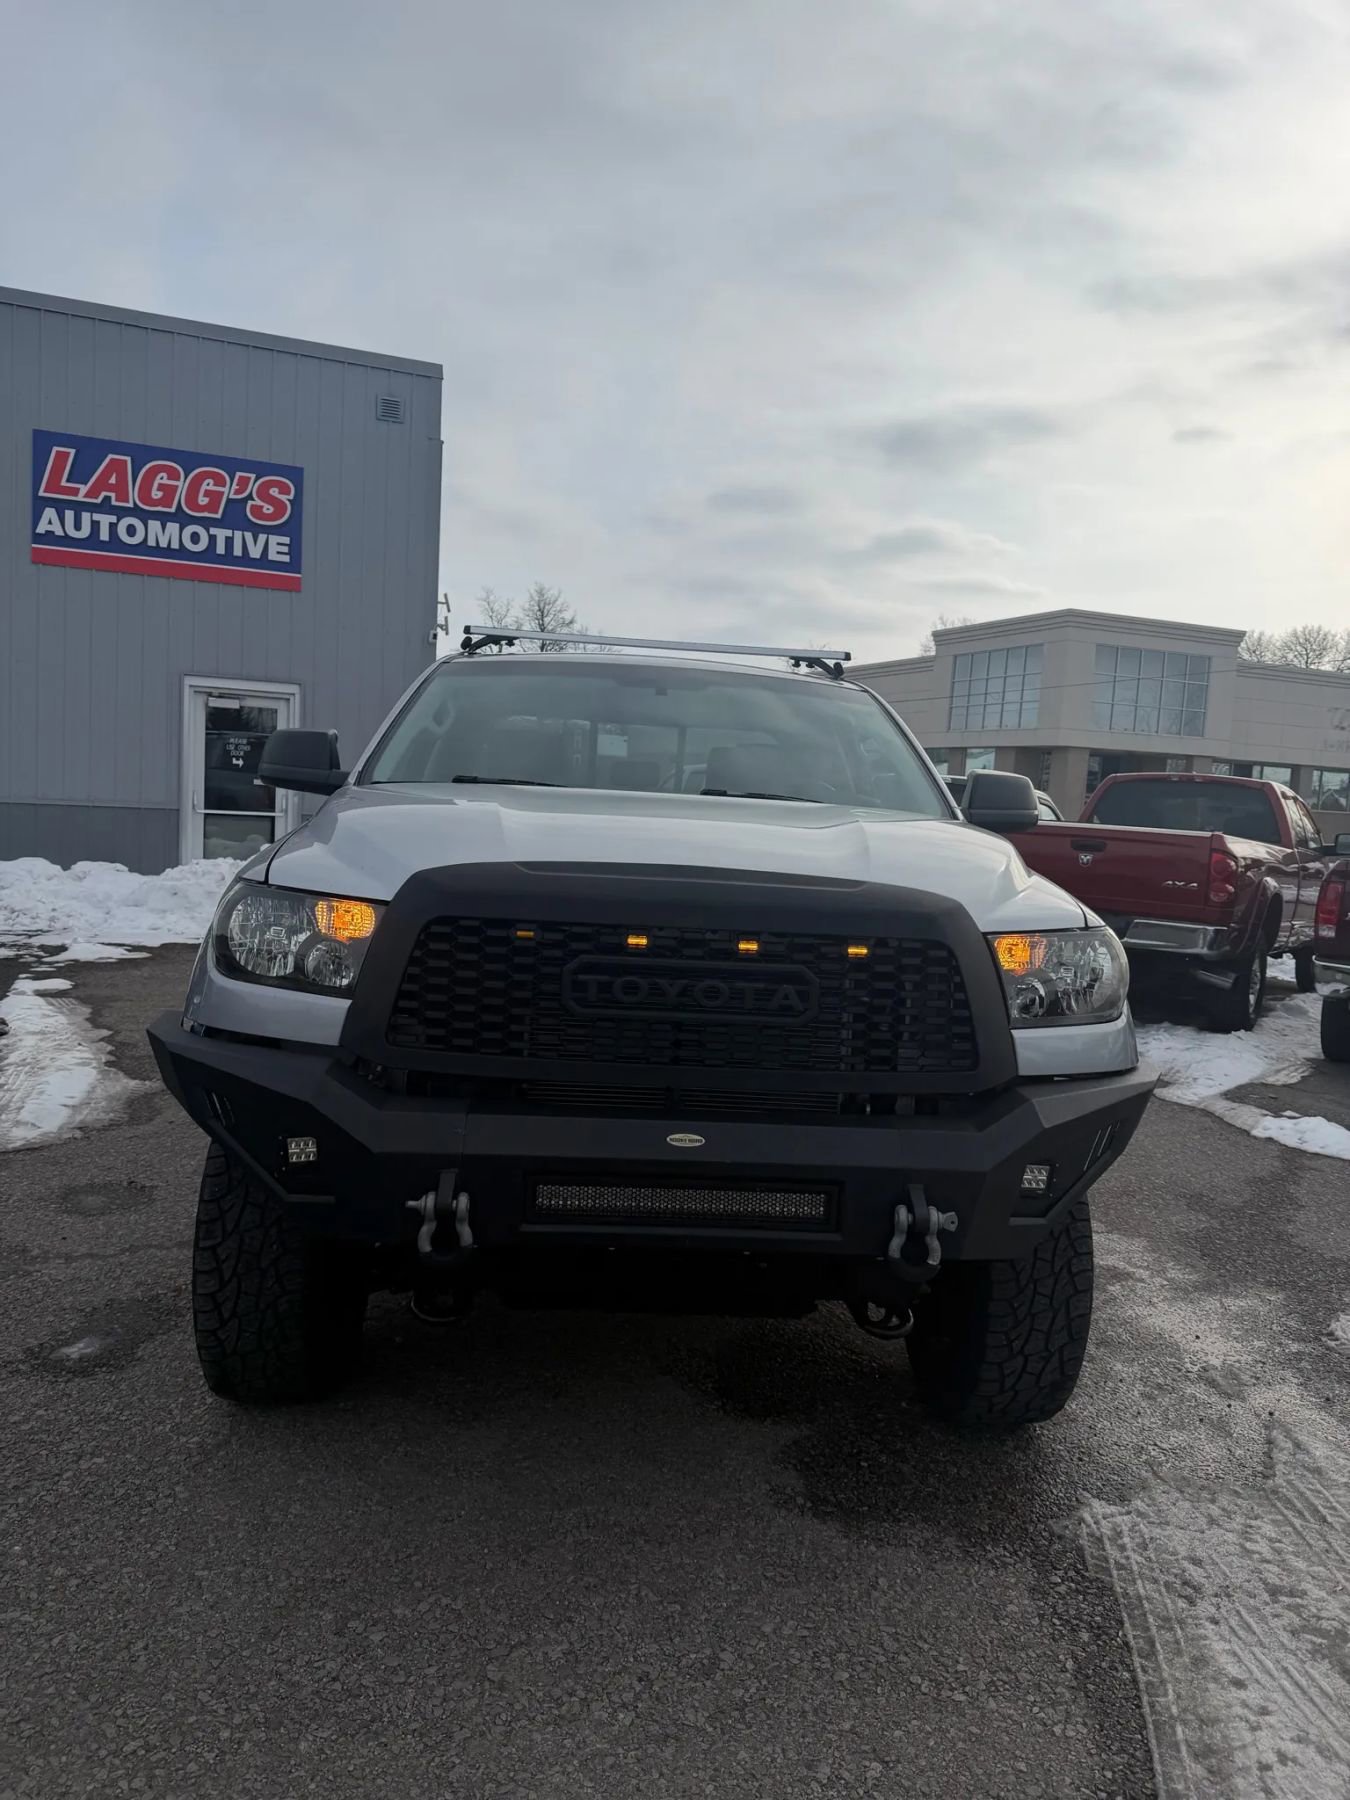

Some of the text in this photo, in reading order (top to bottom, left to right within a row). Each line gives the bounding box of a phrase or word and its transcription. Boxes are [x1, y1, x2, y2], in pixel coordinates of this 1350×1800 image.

[38, 446, 295, 525] LAGG'S
[35, 507, 291, 563] AUTOMOTIVE
[575, 974, 806, 1012] TOYOTA
